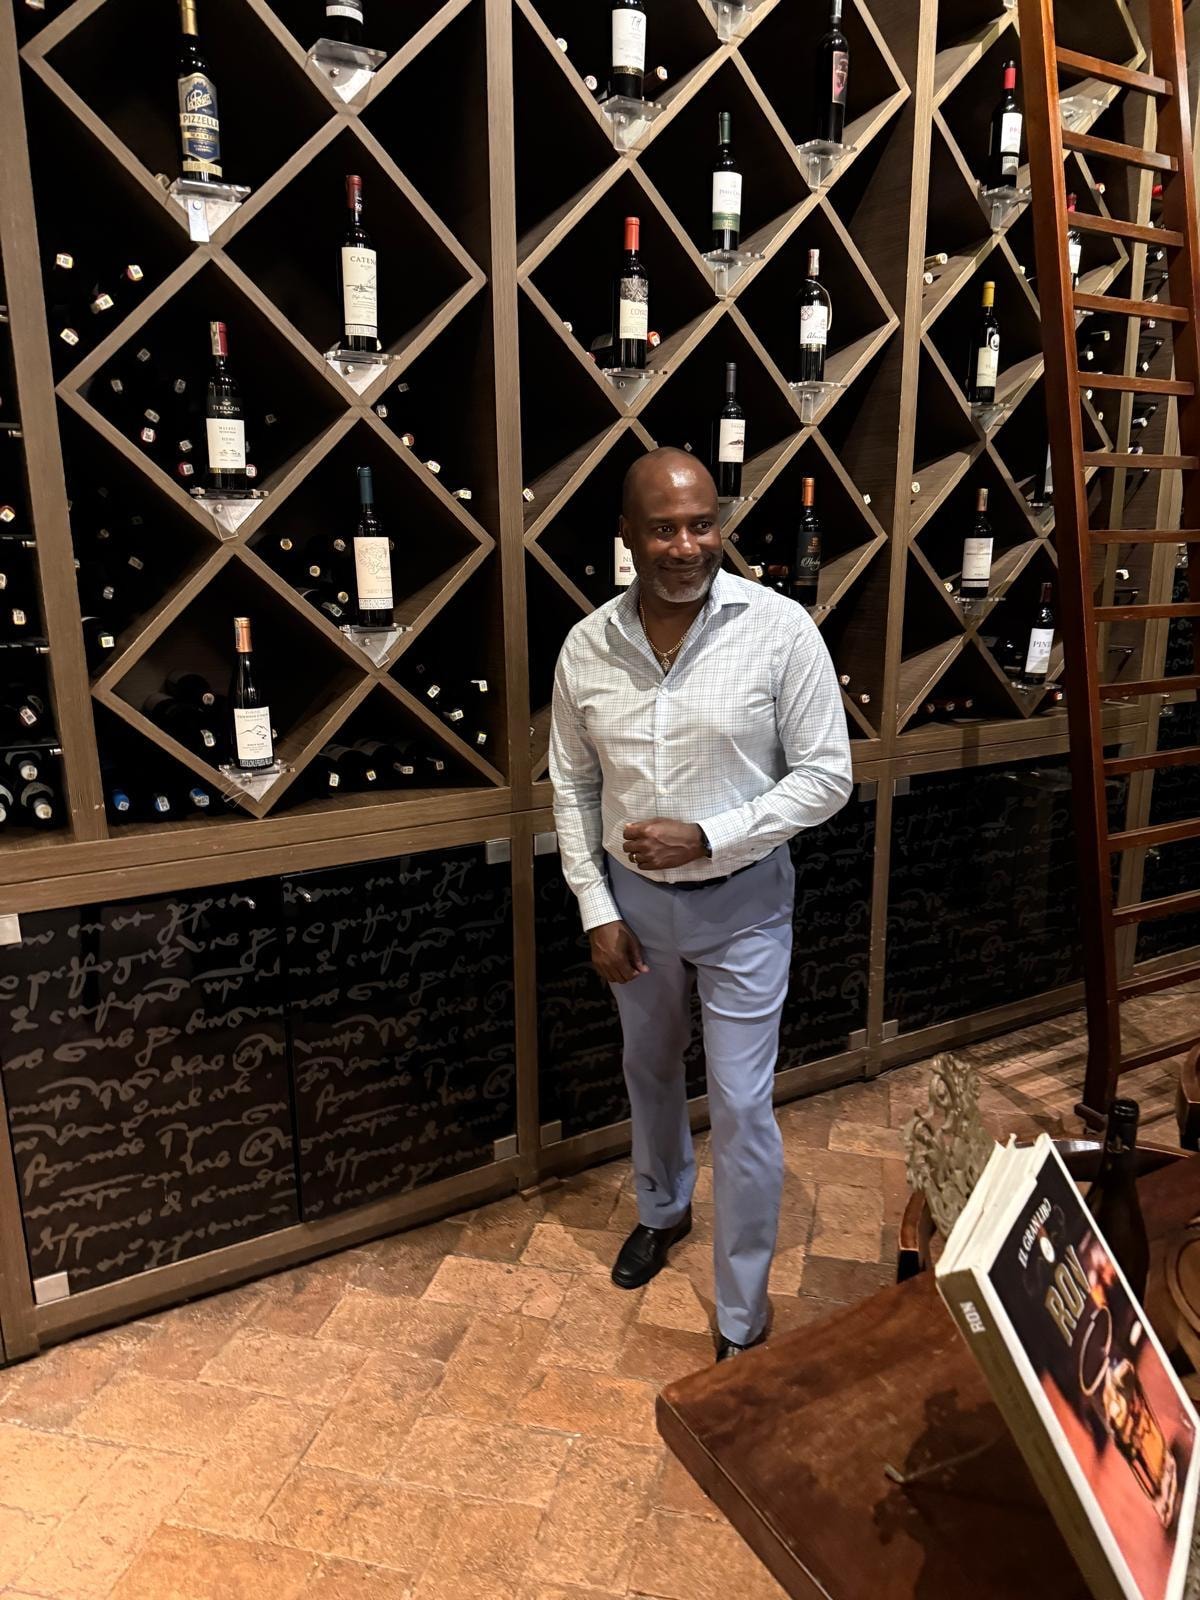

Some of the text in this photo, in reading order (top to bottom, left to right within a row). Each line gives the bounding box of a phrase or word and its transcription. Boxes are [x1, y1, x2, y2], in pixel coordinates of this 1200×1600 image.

[182, 114, 219, 129] PIZZELLA
[1022, 1214, 1043, 1253] GRAN
[1017, 1247, 1029, 1270] EL
[1044, 1243, 1092, 1348] RON
